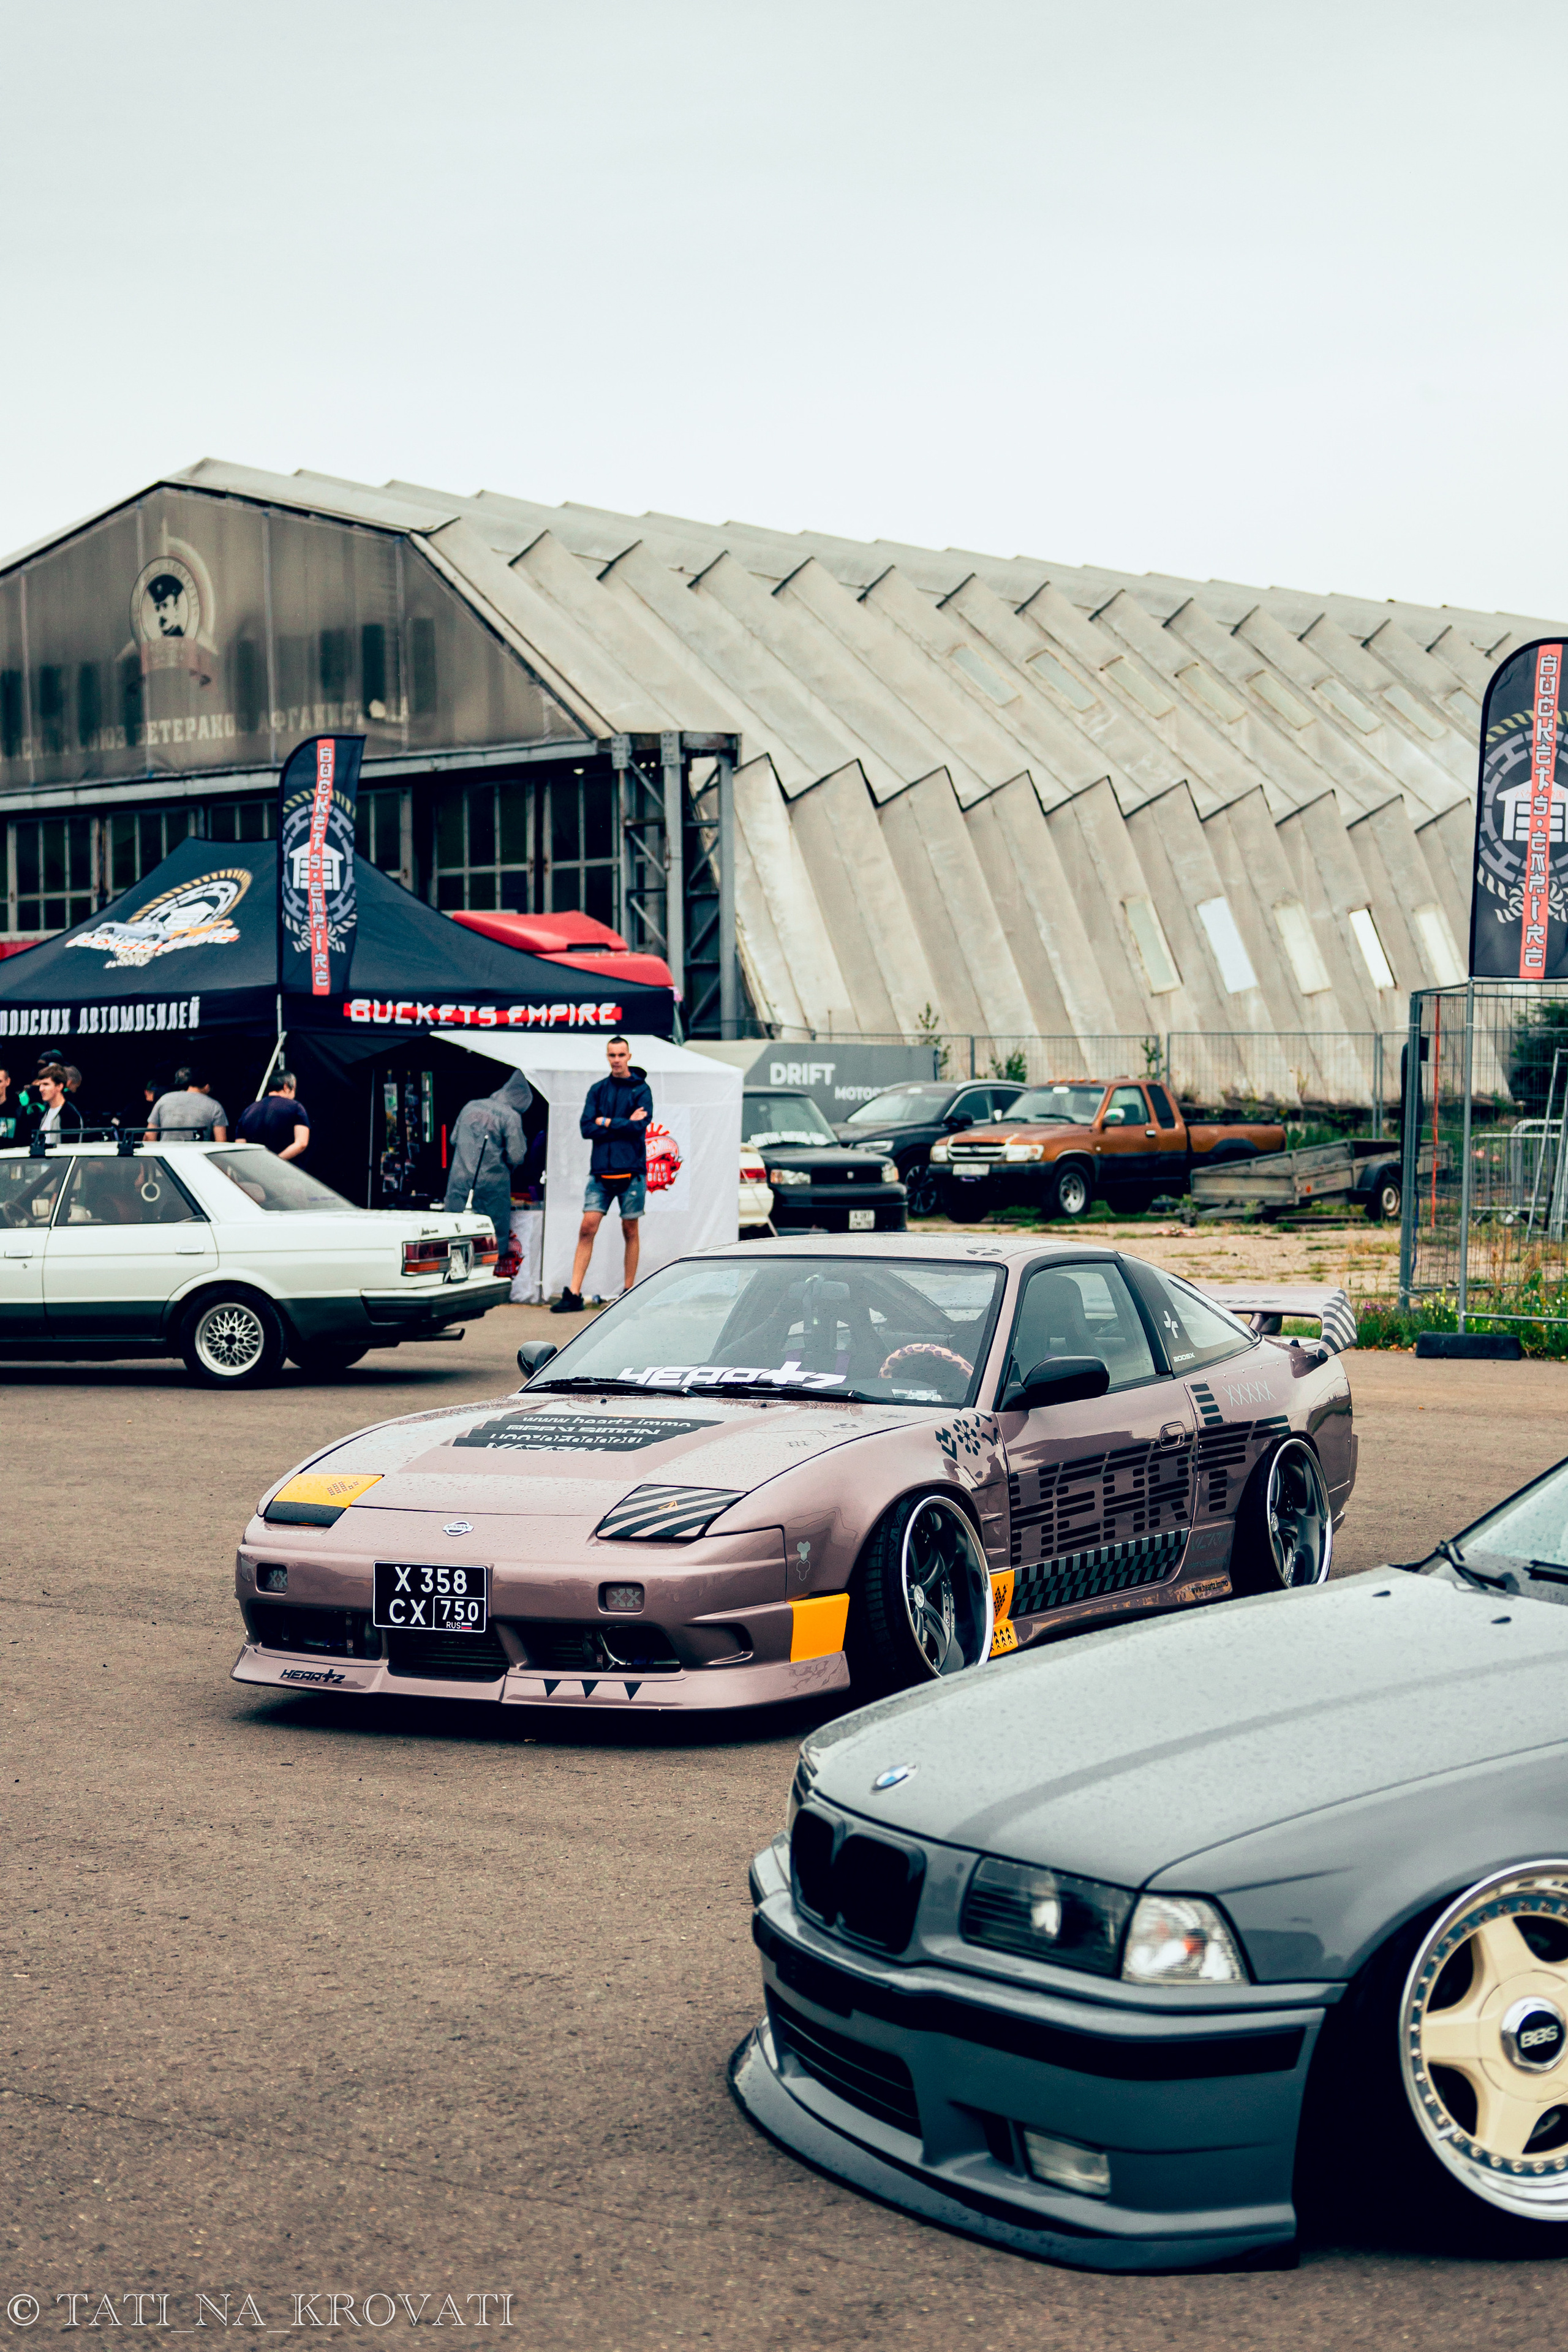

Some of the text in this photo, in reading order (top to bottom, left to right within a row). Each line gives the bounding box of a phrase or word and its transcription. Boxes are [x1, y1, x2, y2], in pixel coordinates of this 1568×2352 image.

[136, 714, 248, 746] ЕТЕРАНО
[309, 746, 333, 869] BUCKETS
[1525, 654, 1558, 968] BUCKETS EMPIRE
[310, 880, 328, 987] EMPIRE
[77, 995, 200, 1034] АВТОМОБИЛЕЙ
[349, 998, 617, 1027] BUCKETS EMPIRE
[770, 1062, 835, 1085] DRIFT
[834, 1085, 889, 1101] MOTOR
[1173, 1352, 1196, 1362] 200SX
[394, 1566, 467, 1594] X 358
[389, 1599, 479, 1625] CX 750
[446, 1621, 461, 1629] RUS
[1521, 2025, 1558, 2049] BBS
